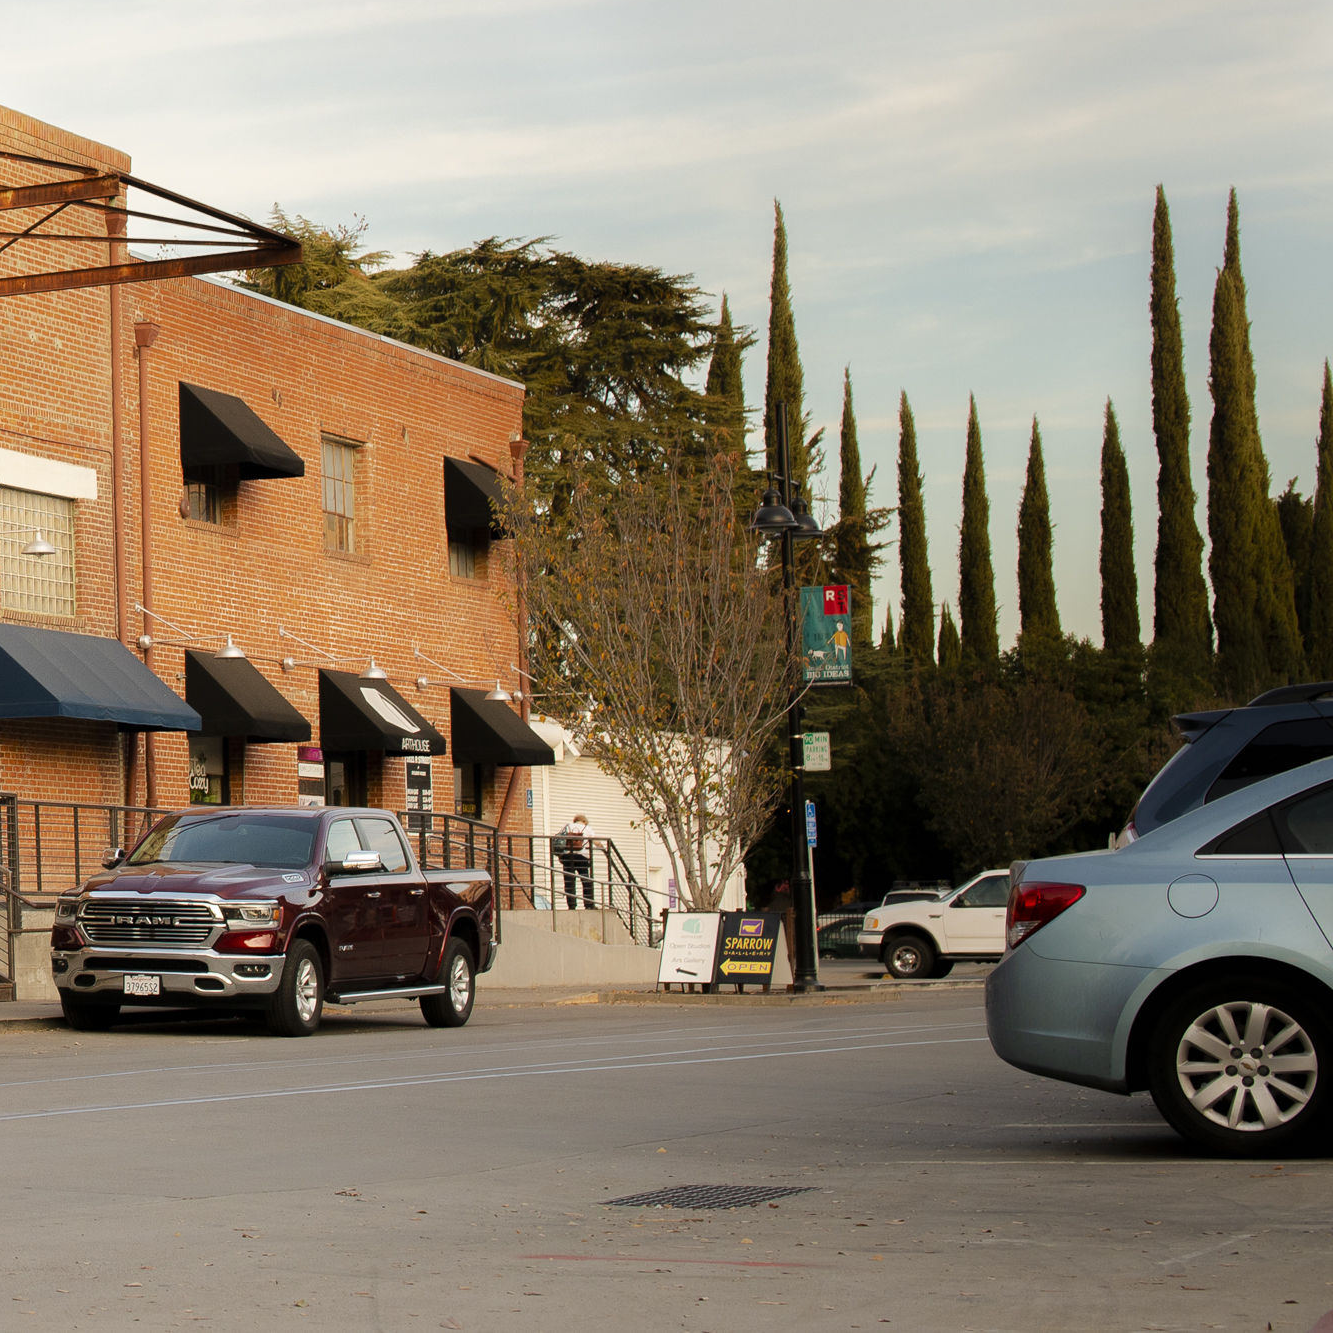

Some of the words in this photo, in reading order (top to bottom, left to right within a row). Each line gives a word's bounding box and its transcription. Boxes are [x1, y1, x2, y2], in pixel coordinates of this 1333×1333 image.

[825, 589, 835, 601] R
[823, 669, 850, 678] IDEAS
[401, 737, 430, 752] ARTHOUSE
[805, 735, 813, 743] 90
[190, 756, 206, 777] Tea
[189, 772, 209, 794] Cozy
[116, 916, 171, 925] RAM
[725, 937, 773, 950] SPARROW
[727, 963, 768, 971] OPEN
[126, 981, 158, 993] 37965S2
